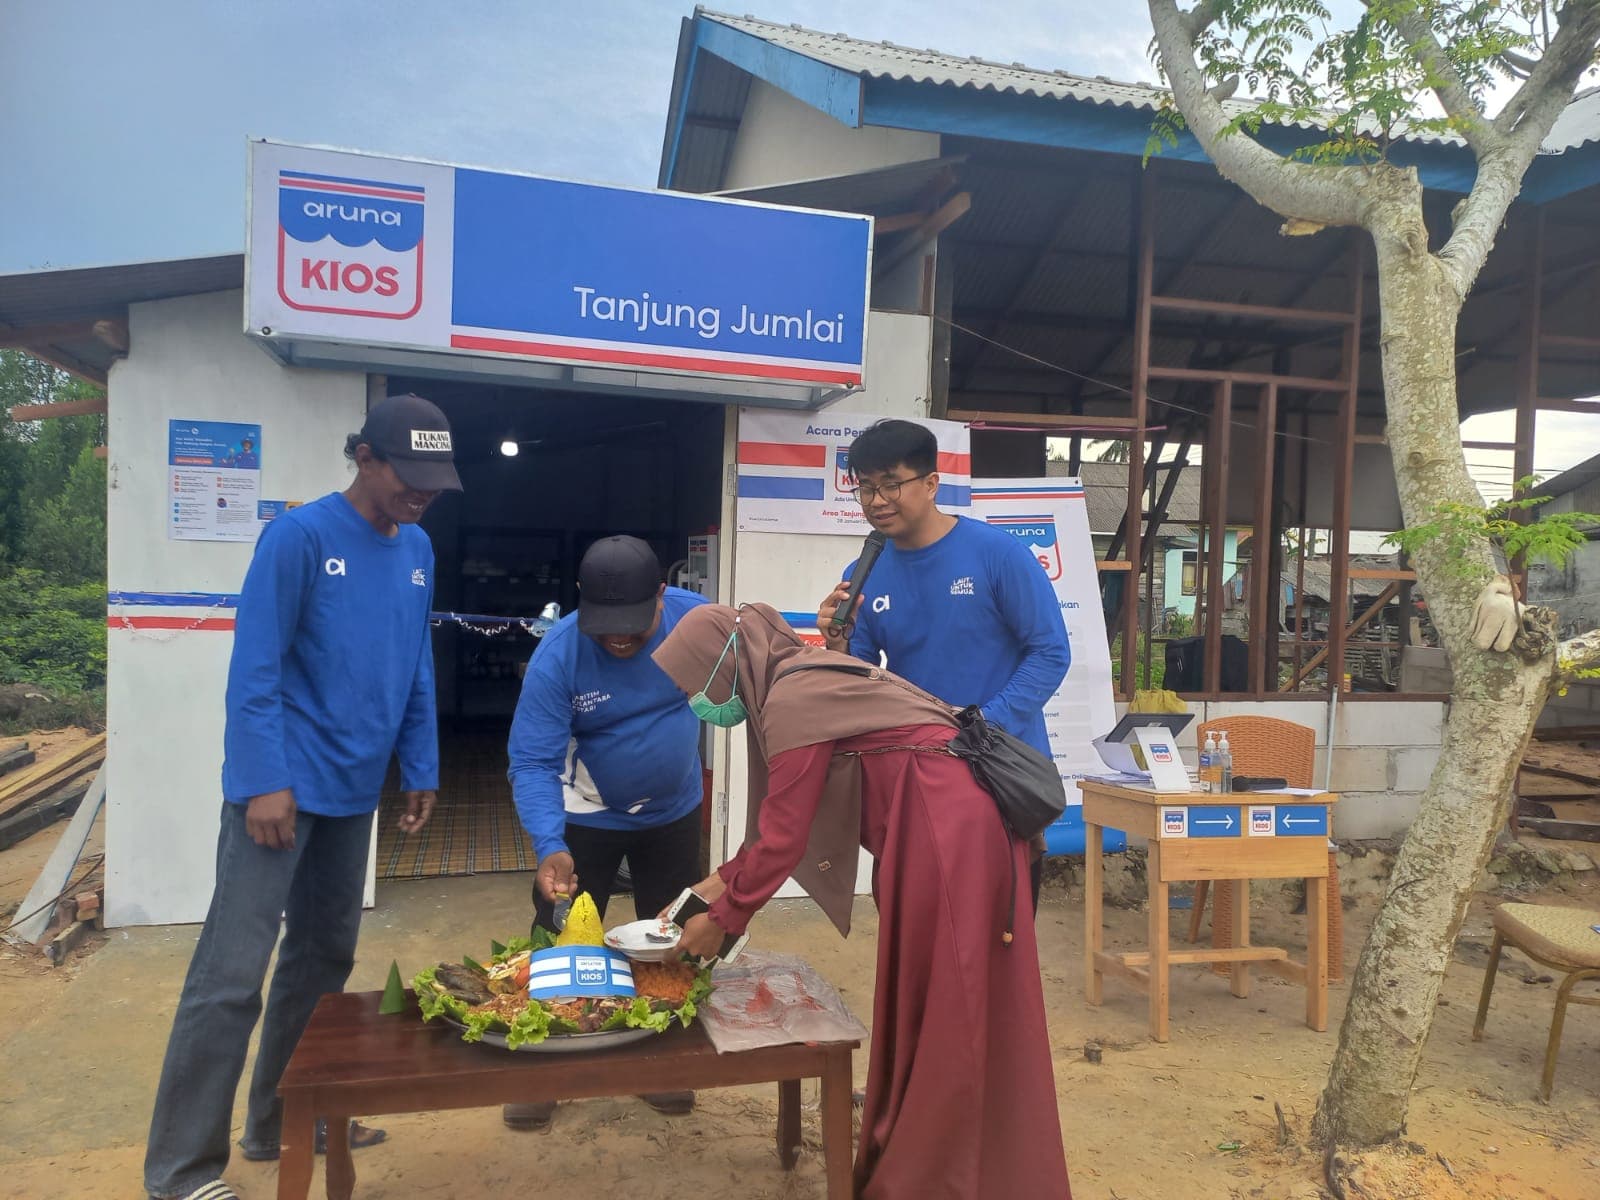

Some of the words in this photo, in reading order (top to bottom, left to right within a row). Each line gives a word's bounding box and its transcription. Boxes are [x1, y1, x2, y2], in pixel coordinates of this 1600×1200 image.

[303, 202, 402, 226] aruna
[301, 258, 399, 296] KIOS
[573, 287, 720, 339] Tanjung
[731, 304, 845, 343] Jumlai
[806, 425, 841, 436] Acara
[581, 973, 602, 981] KIOS
